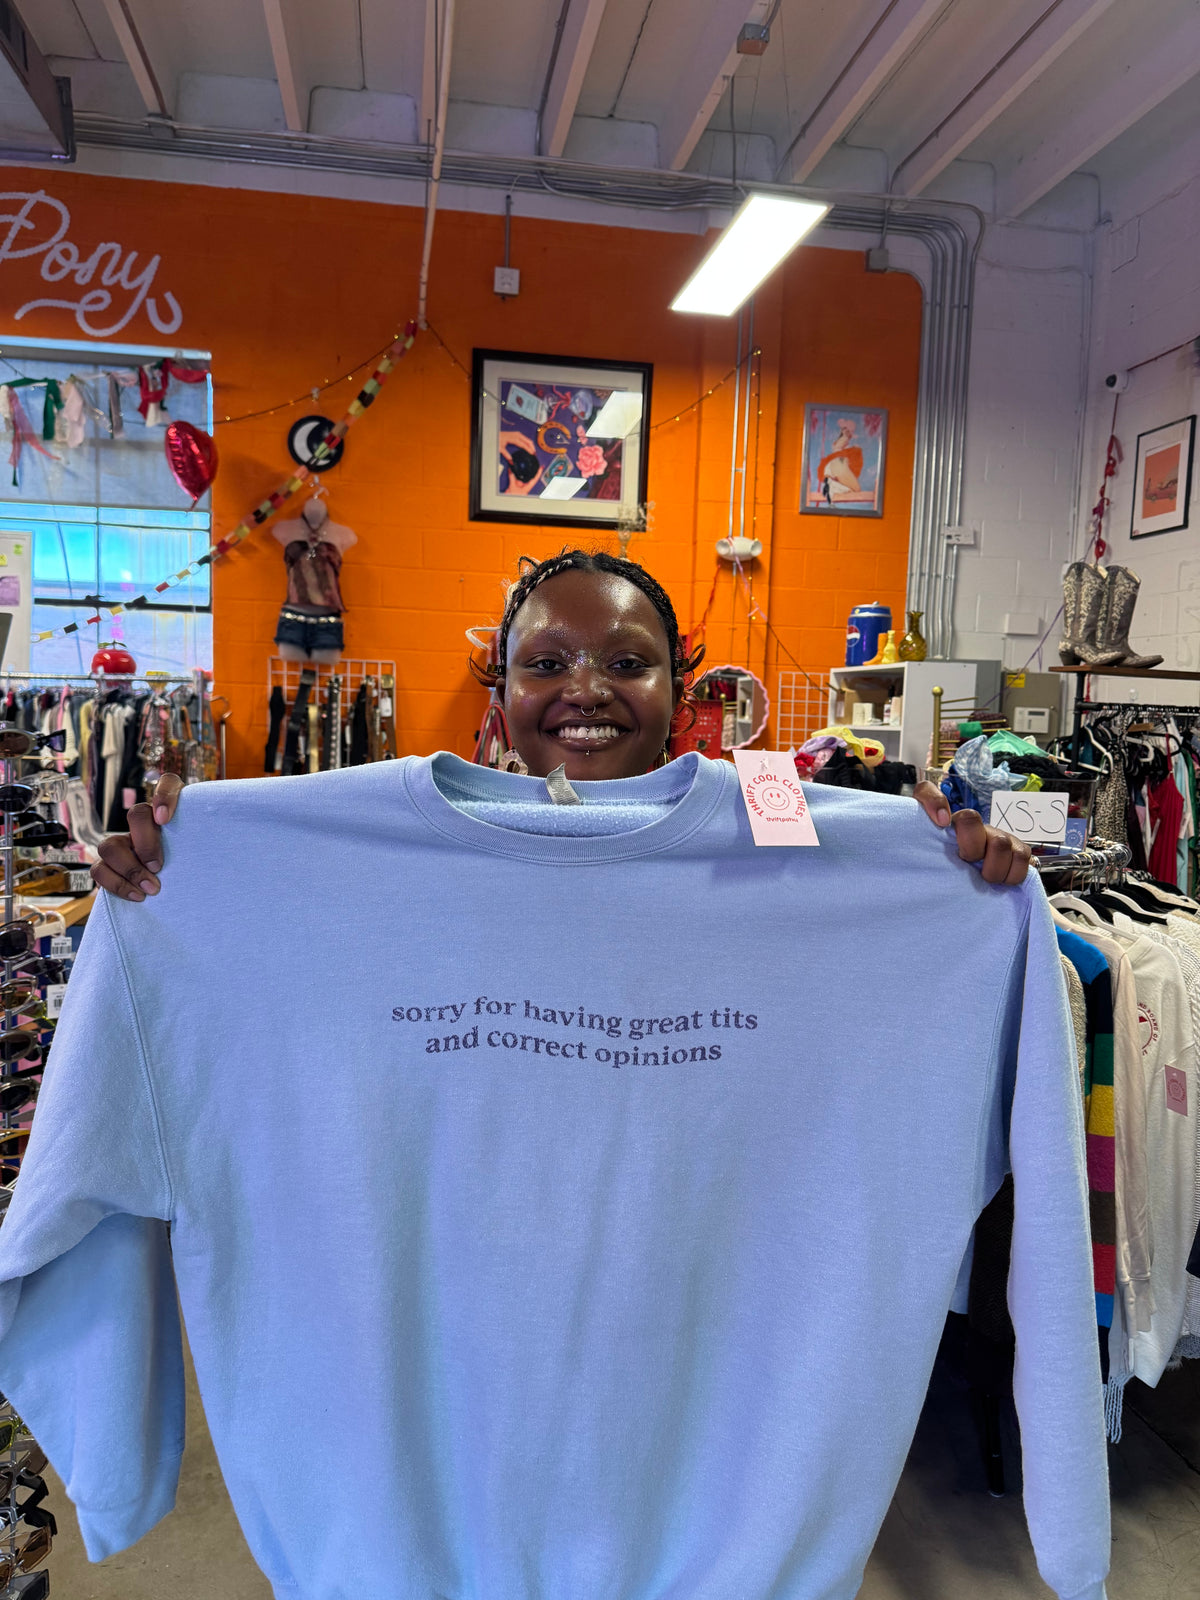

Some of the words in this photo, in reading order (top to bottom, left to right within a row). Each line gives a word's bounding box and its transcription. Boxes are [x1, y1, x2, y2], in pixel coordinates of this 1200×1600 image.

[0, 190, 163, 337] Pony
[746, 783, 764, 816] THRIFT
[752, 773, 779, 785] COOL
[782, 779, 806, 818] CLOTHES
[392, 1000, 467, 1023] sorry
[475, 996, 517, 1015] for
[524, 1000, 622, 1038] having
[628, 1009, 703, 1040] great
[709, 1007, 759, 1030] tits
[425, 1026, 480, 1053] and
[486, 1029, 588, 1060] correct
[594, 1042, 723, 1069] opinions
